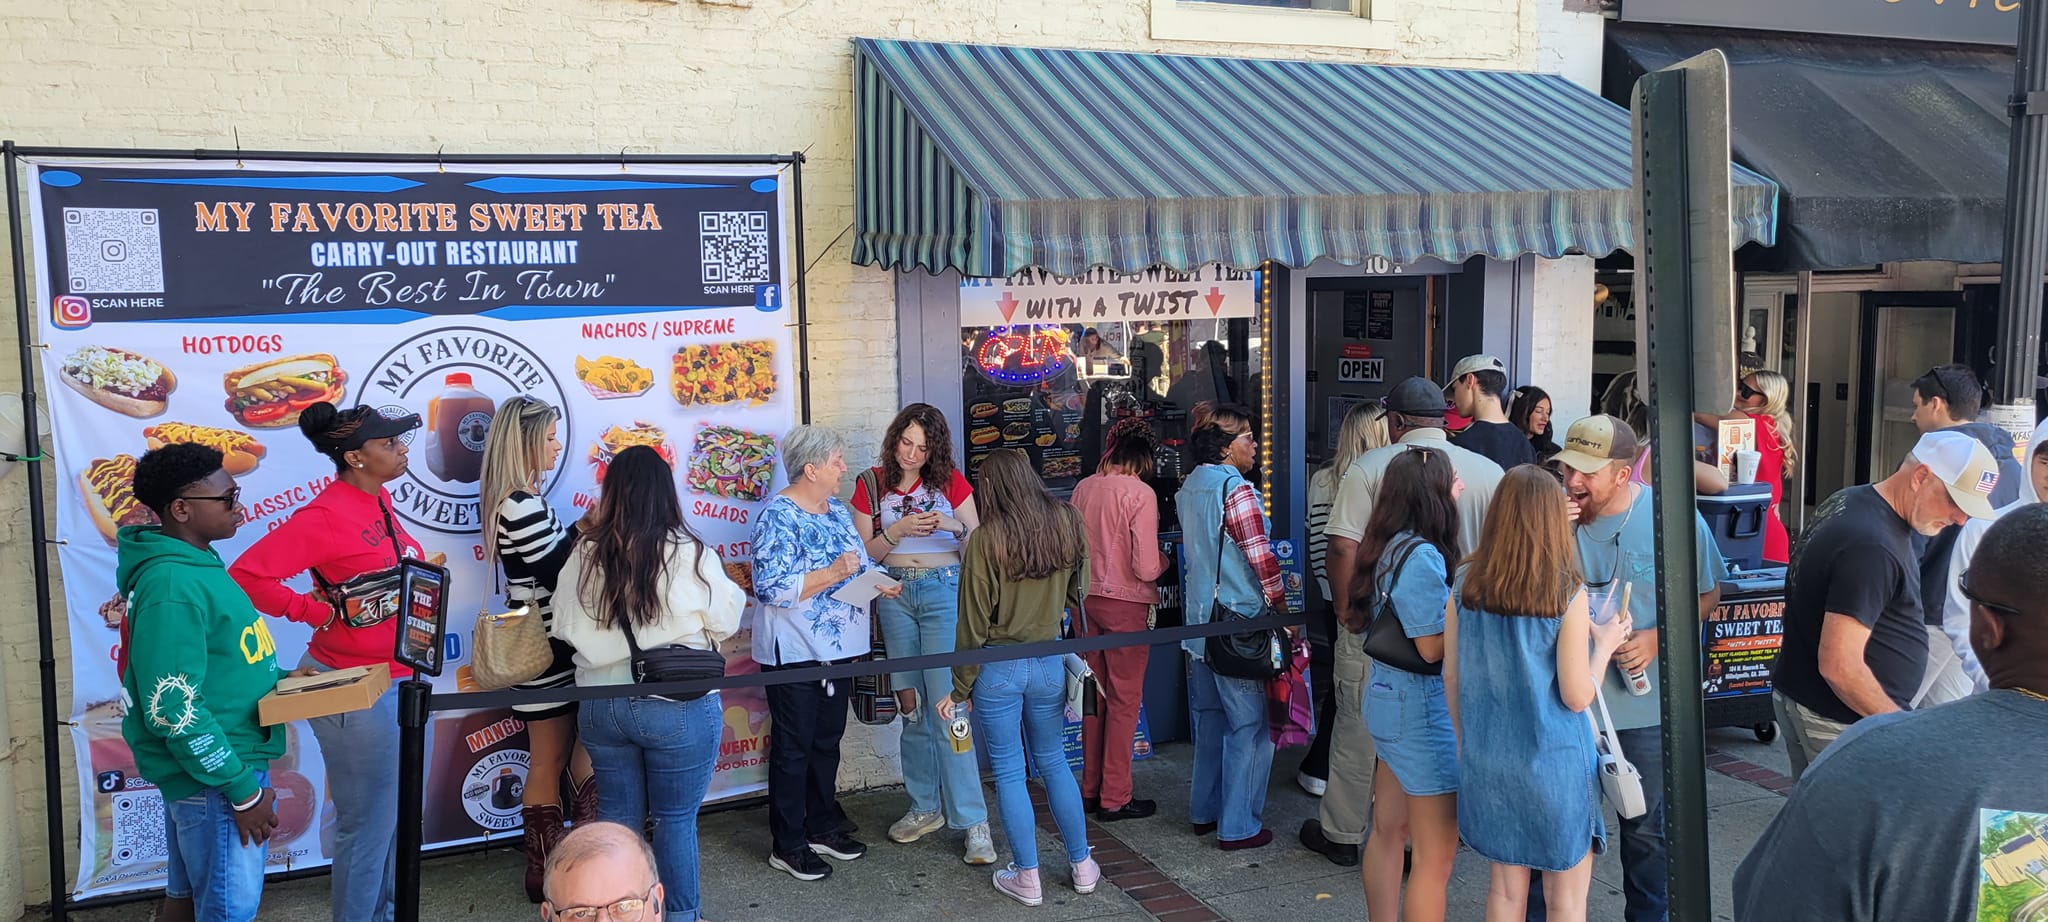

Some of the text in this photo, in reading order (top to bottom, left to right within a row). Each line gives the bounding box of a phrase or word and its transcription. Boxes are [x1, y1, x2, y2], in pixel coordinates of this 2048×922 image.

[194, 201, 663, 232] MY FAVORITE SWEET TEA
[310, 240, 578, 267] CARRY-OUT RESTAURANT
[262, 269, 616, 305] "The Best In Town"
[703, 284, 755, 295] SCAN HERE
[92, 297, 165, 309] SCAN HERE
[1026, 290, 1198, 319] WITH A TWIST
[581, 318, 736, 340] NACHOS / SUPREME
[182, 334, 283, 355] HOTDOGS
[978, 333, 1064, 369] OPEN
[377, 336, 544, 395] MY FAVORITE
[1341, 360, 1381, 379] OPEN
[243, 486, 307, 522] LASSIC
[391, 481, 481, 525] SWEET
[692, 500, 748, 525] SALADS
[412, 591, 432, 608] THE
[1708, 605, 1730, 622] MY
[407, 616, 436, 634] STARTS
[1715, 621, 1760, 638] SWEET
[466, 717, 525, 753] MANGO
[471, 762, 488, 779] MY
[475, 812, 517, 828] SWEET
